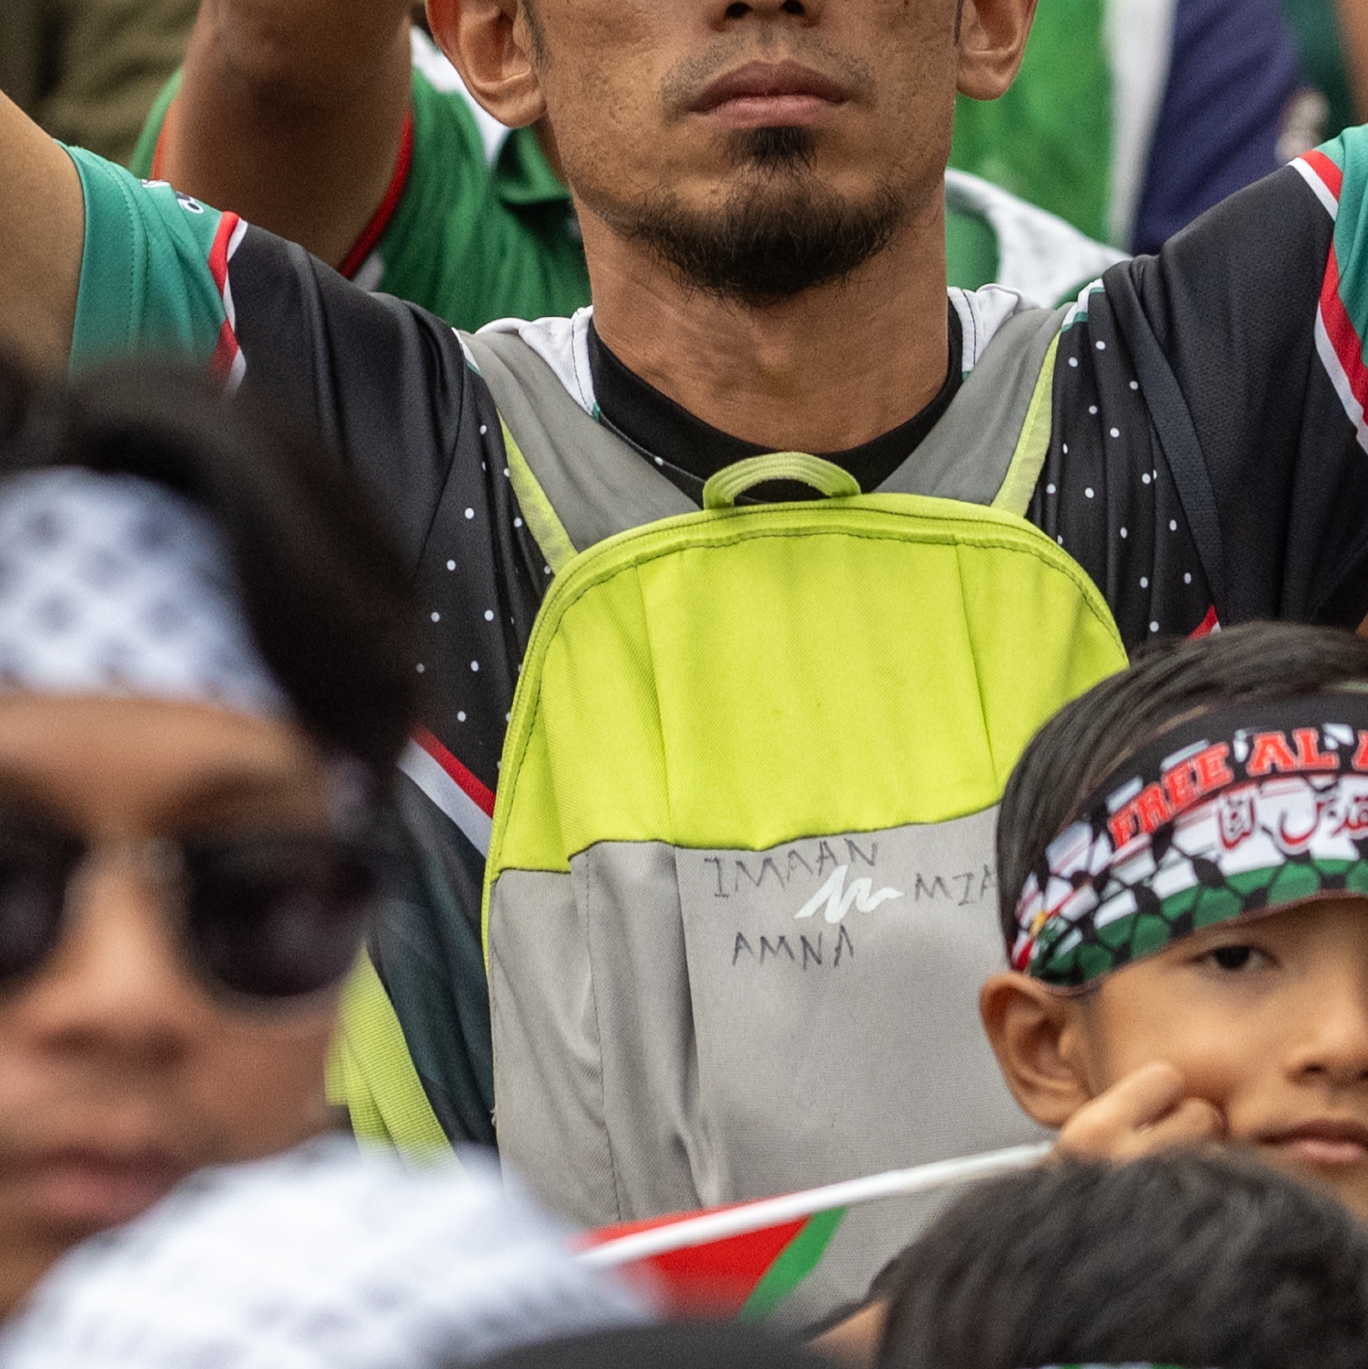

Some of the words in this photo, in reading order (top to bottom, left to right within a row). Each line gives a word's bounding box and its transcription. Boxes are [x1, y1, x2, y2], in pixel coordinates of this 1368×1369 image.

[1107, 742, 1236, 849] FREE
[1245, 728, 1340, 777] AL
[731, 923, 855, 970] AMNA
